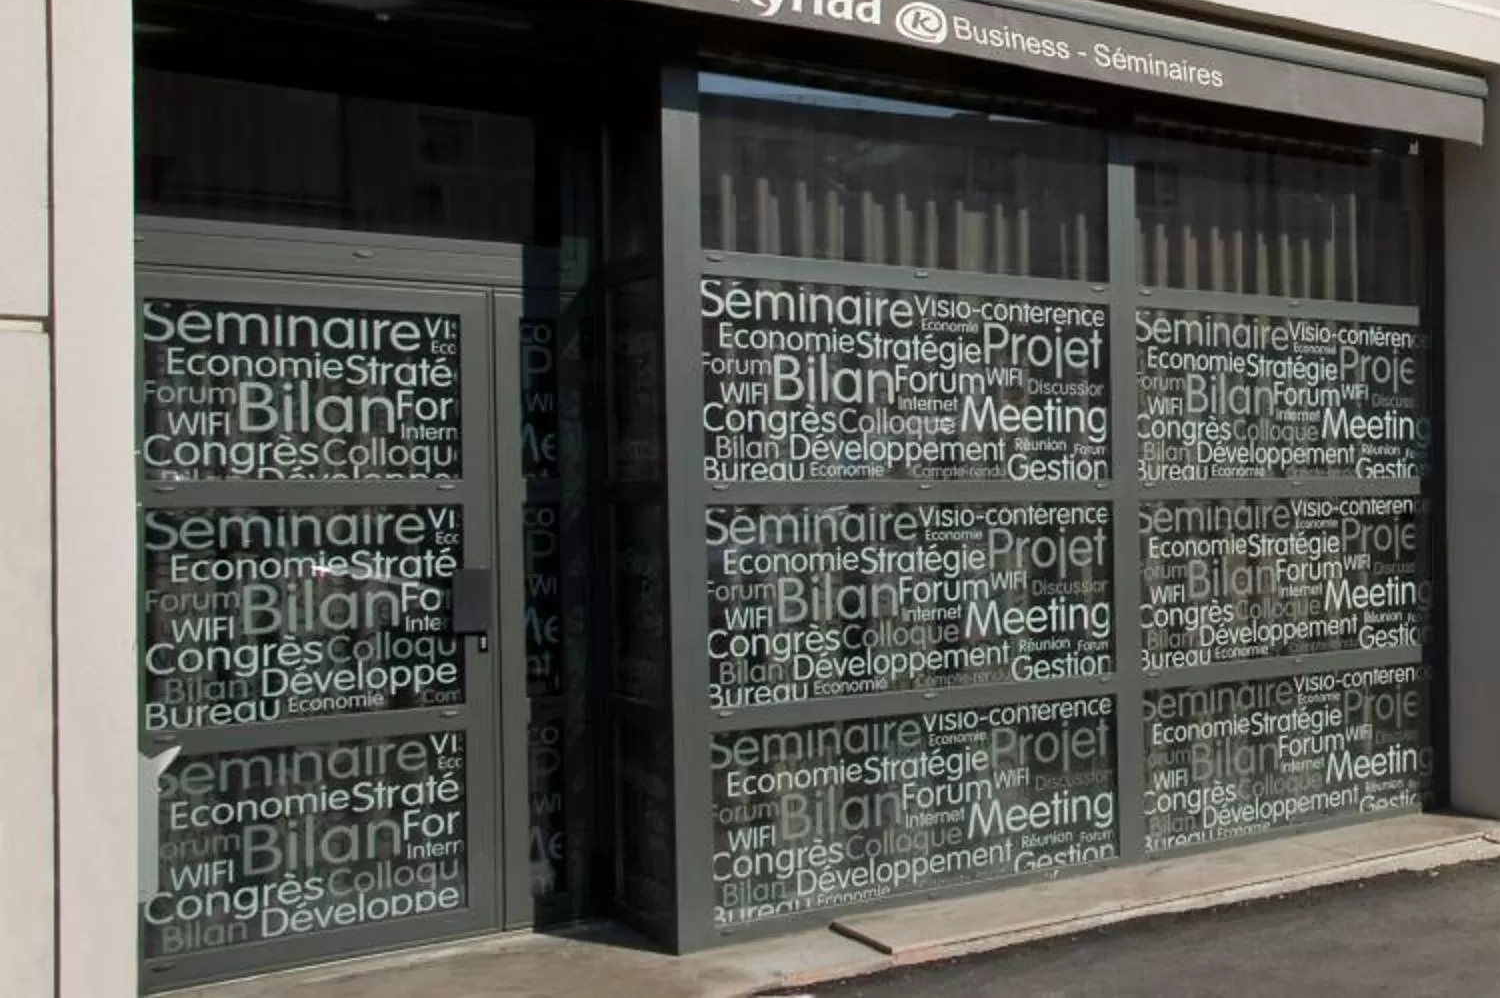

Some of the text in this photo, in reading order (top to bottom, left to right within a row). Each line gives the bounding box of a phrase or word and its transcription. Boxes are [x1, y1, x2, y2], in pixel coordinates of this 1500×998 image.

[953, 15, 1070, 59] Business
[1094, 43, 1223, 87] Séminaires
[168, 347, 456, 387] Economie Straté
[720, 321, 855, 354] Economie
[857, 331, 981, 371] Stratégie
[983, 322, 1104, 379] Projet
[1147, 345, 1339, 387] Economie Stratégie
[702, 352, 772, 375] Forum
[773, 353, 895, 404] Bilan
[894, 363, 985, 394] Forum
[985, 367, 1023, 387] WIFI
[1187, 373, 1275, 416] Bilan
[1273, 381, 1341, 408] Forum
[144, 380, 454, 434] Forum Bilan For
[168, 411, 231, 437] WIFI
[703, 402, 838, 441] Congrès
[839, 407, 955, 442] Colloque
[720, 381, 1107, 443] WIFI Internet Meeting
[1148, 396, 1183, 417] WIFI
[716, 432, 1006, 469] Bilan Développement
[1137, 414, 1233, 446] Congrès
[144, 435, 454, 475] Congrès Colloqu
[704, 454, 1107, 483] Bureau Economie Gestion
[1198, 438, 1355, 471] Développement
[723, 546, 859, 576] Economie
[861, 546, 985, 580] Stratégie
[987, 527, 1108, 579] Projet
[1149, 532, 1341, 559] Economie Stratégie
[171, 550, 348, 584] Economie
[1189, 557, 1343, 599] Bilan Forum
[145, 579, 401, 635] Forum Bilan
[724, 606, 773, 630] WIFI
[964, 597, 1111, 640] Meeting
[778, 573, 899, 624] Bilan
[899, 573, 990, 604] Forum
[990, 571, 1028, 592] WIFI
[1140, 599, 1235, 632] Congrès
[172, 617, 234, 643] WIFI
[707, 622, 959, 662] Congrès Colloque
[1200, 612, 1358, 648] Développement
[145, 635, 323, 677] Congrès
[793, 642, 1011, 682] Développement
[263, 664, 457, 698] Développe
[289, 692, 384, 713] Economie
[1153, 704, 1343, 745] Economie Stratégie
[1279, 730, 1346, 759] Forum
[727, 760, 863, 800] Economie
[864, 746, 990, 788] Stratégie
[170, 785, 349, 831] Economie
[727, 825, 777, 853] WIFI
[967, 790, 1114, 841] Meeting
[780, 783, 903, 842] Bilan
[901, 778, 994, 812] Forum
[1203, 785, 1361, 830] Développement
[244, 812, 401, 877] Bilan
[712, 839, 845, 884] Congrès
[171, 858, 234, 892] WIFI
[796, 842, 1013, 899] Développement
[144, 873, 325, 926] Congrès
